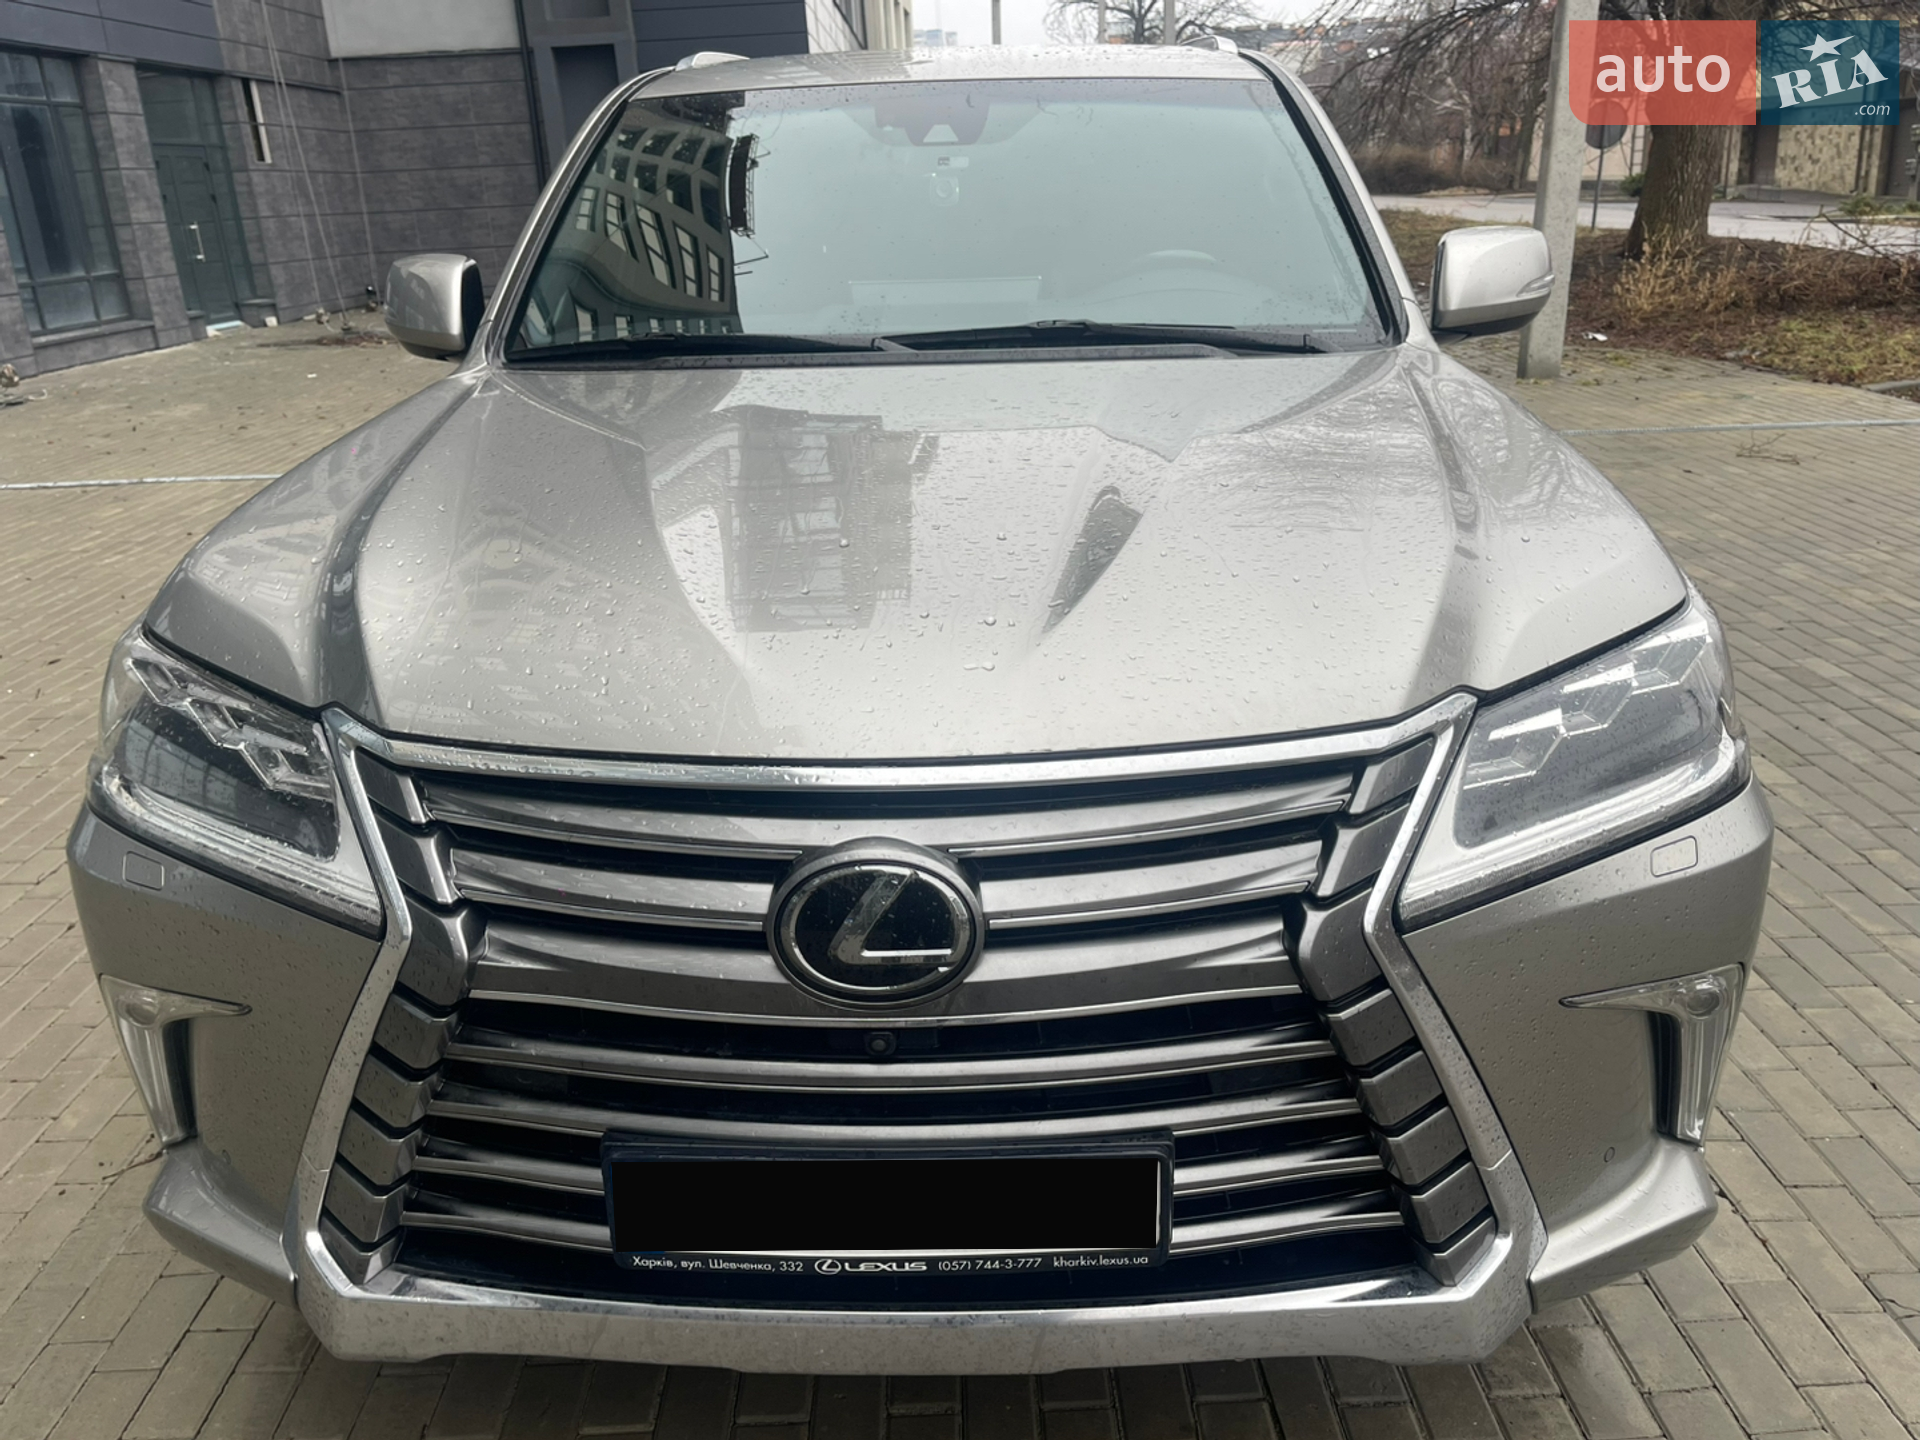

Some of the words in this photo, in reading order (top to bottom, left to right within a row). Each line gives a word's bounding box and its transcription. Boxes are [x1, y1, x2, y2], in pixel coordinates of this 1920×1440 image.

[633, 1256, 677, 1269] Харків,
[681, 1260, 705, 1270] вул.
[709, 1259, 775, 1272] Шевченка,
[779, 1262, 803, 1272] 332
[845, 1262, 928, 1272] LEXUS
[939, 1258, 971, 1272] (057)
[975, 1258, 1042, 1270] 744-3-777
[1053, 1255, 1149, 1268] kharkiv.lexus.ua
